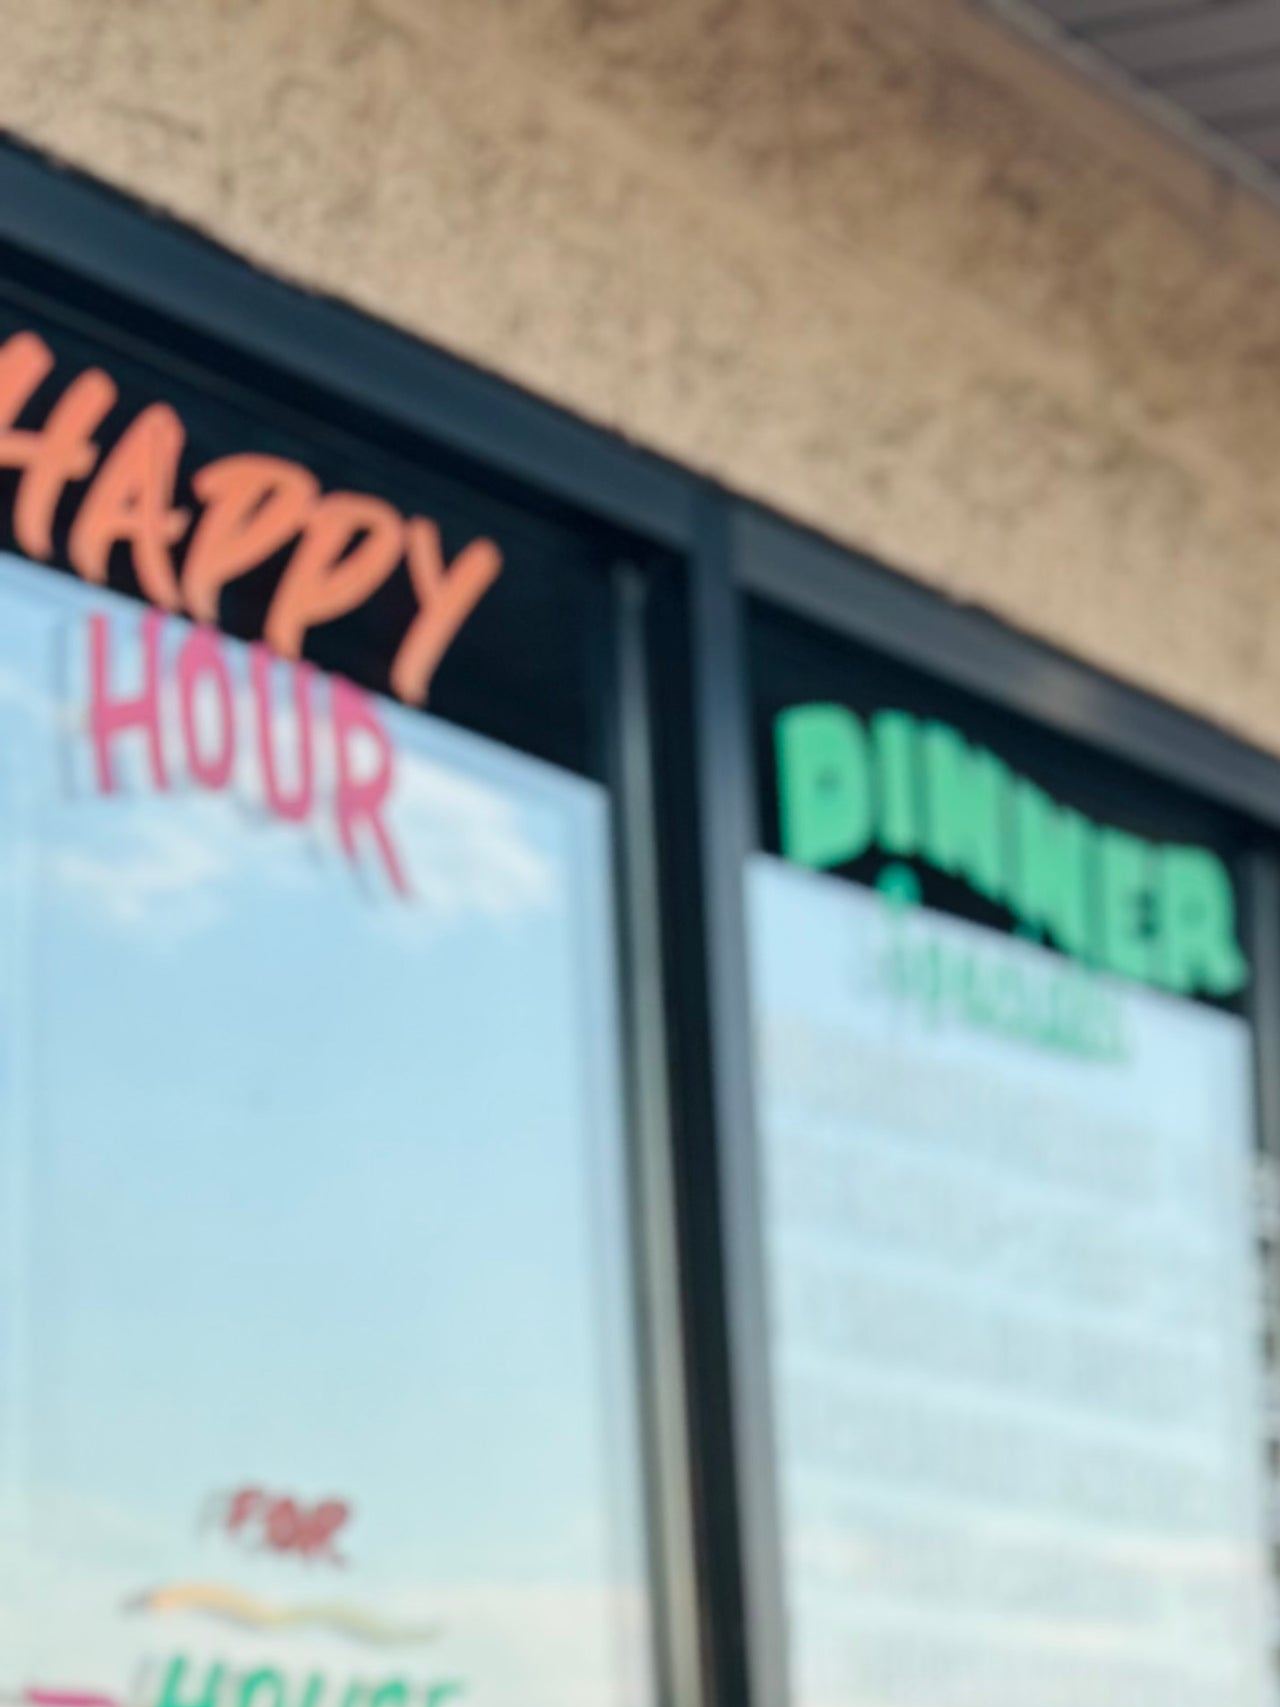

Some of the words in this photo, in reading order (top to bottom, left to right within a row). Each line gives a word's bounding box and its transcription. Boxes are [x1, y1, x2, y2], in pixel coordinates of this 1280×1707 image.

[0, 330, 503, 706] HAPPY
[88, 606, 415, 905] HOUR
[774, 702, 1247, 998] DINNER
[225, 1487, 352, 1566] FOR
